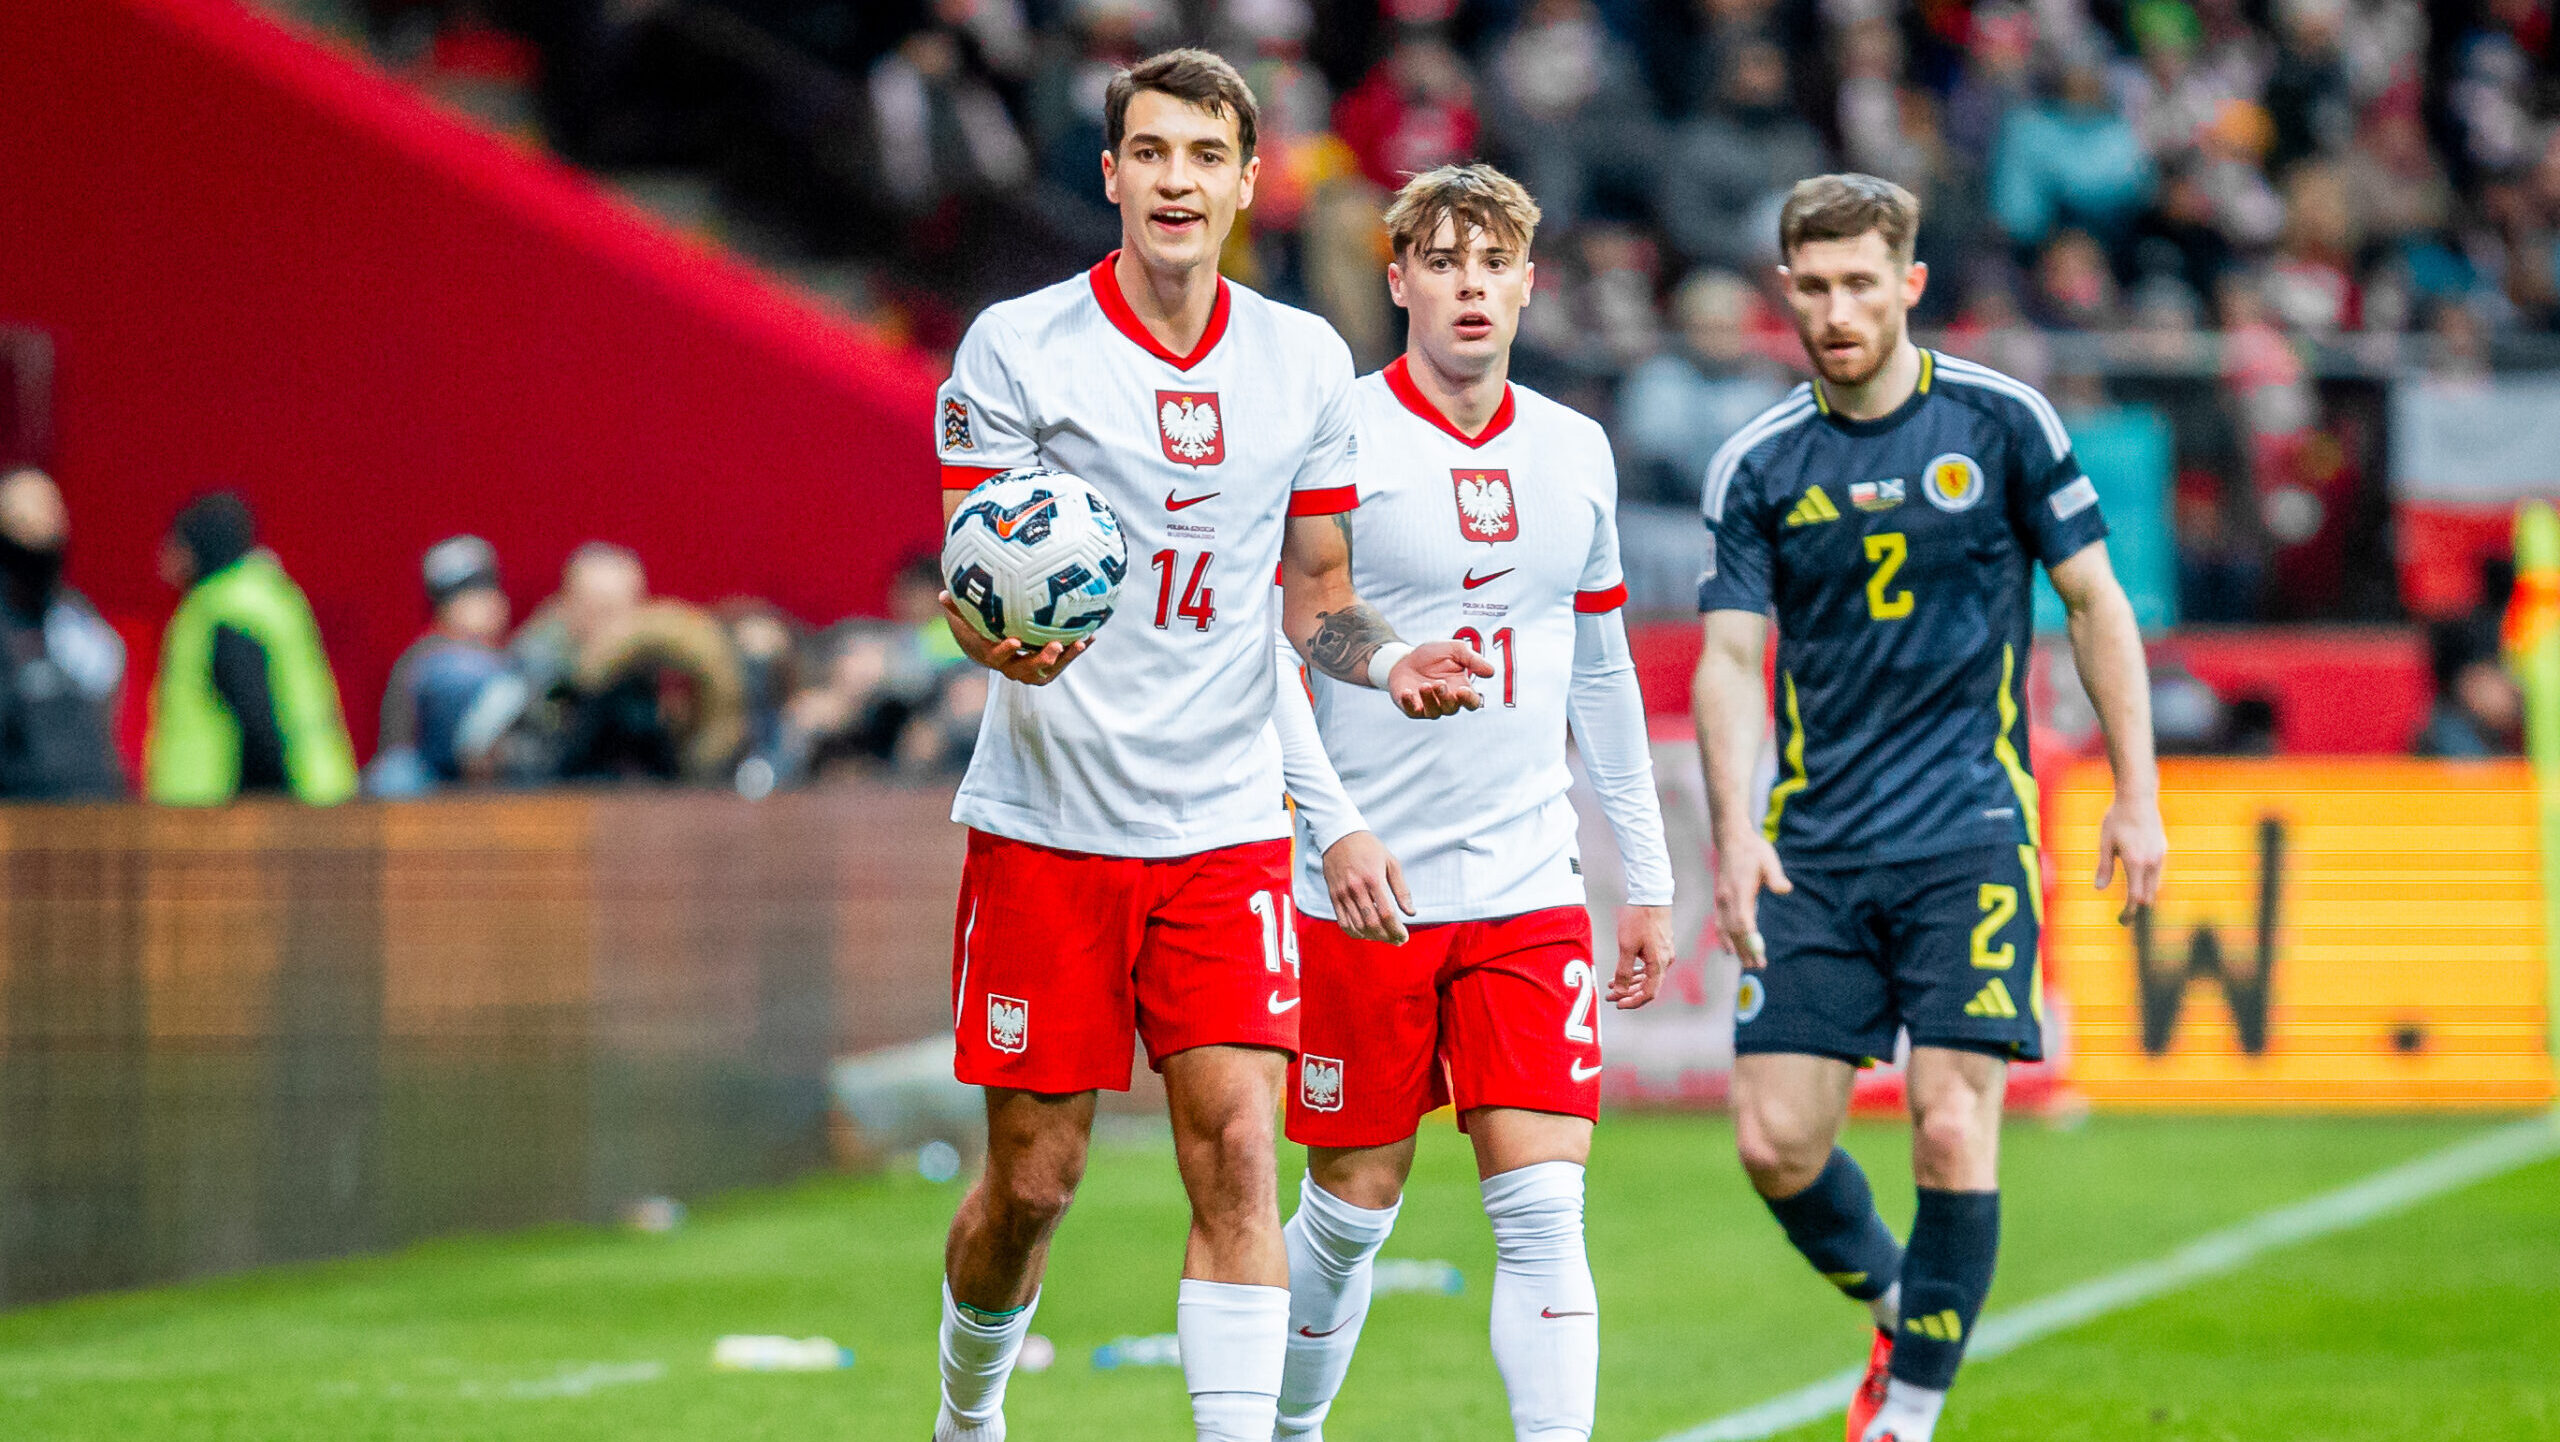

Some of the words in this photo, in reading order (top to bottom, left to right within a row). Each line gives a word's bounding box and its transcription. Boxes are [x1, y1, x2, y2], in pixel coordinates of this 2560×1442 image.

[1152, 548, 1216, 631] 14
[1863, 532, 1914, 620] 2
[1249, 890, 1300, 979] 14
[1970, 883, 2018, 970] 2
